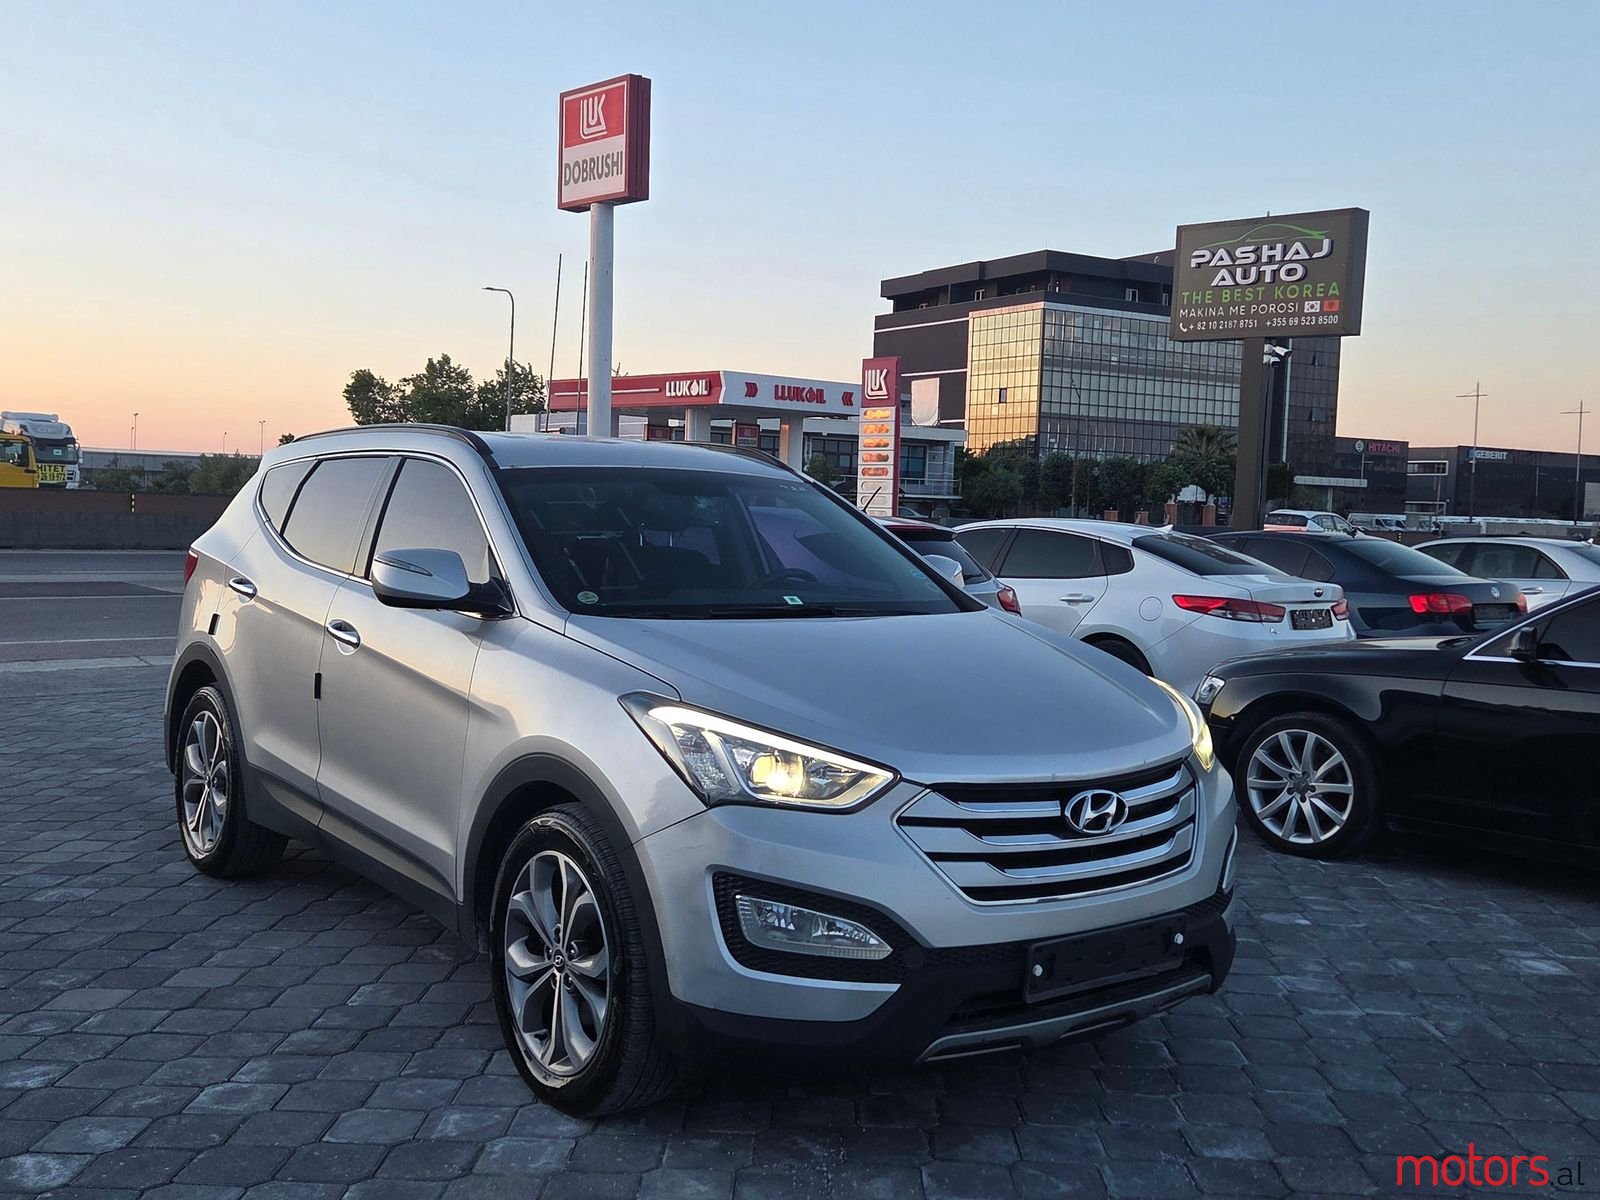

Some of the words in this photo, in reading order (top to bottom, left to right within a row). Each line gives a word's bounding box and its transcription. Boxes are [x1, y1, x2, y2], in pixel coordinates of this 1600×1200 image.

[564, 150, 623, 186] DOBRUSHI
[1190, 238, 1332, 268] PASHAJ
[1210, 262, 1306, 287] AUTO
[1182, 290, 1213, 305] THE
[1221, 286, 1266, 303] BEST
[1274, 281, 1340, 299] KOREA
[1179, 304, 1225, 319] MAKINA
[1229, 304, 1246, 316] ME
[1251, 302, 1299, 315] POROSI
[1208, 321, 1217, 330] 10
[1219, 320, 1237, 330] 2187
[1239, 319, 1258, 328] 8751
[1265, 317, 1287, 327] +355
[1288, 317, 1299, 326] 69
[1300, 316, 1316, 326] 523
[1318, 314, 1339, 325] 8500
[36, 464, 66, 472] HITET
